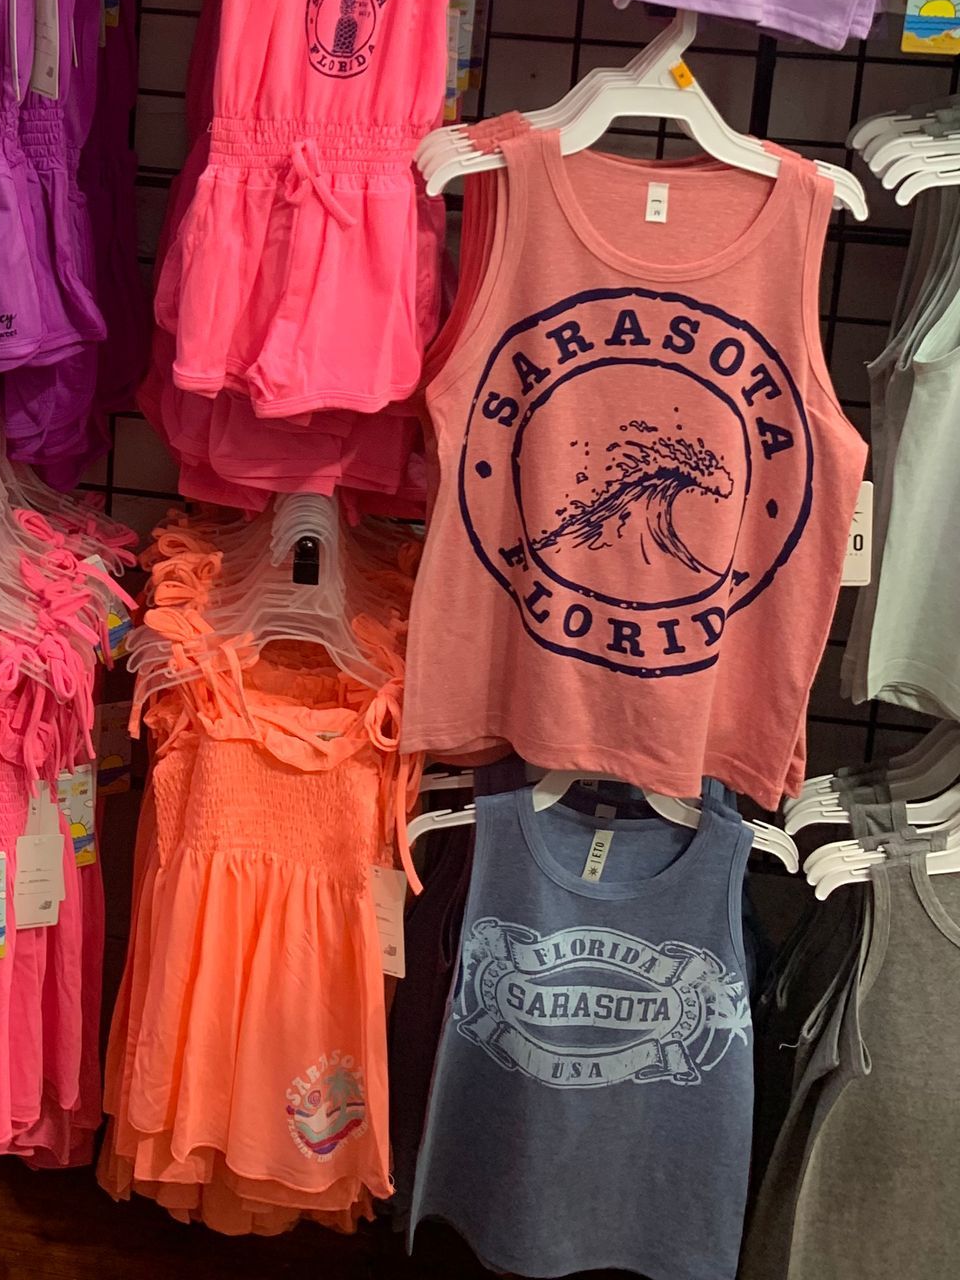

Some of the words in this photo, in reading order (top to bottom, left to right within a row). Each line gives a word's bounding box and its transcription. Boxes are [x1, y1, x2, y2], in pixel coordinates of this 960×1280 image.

[310, 43, 376, 73] FLORIDA
[482, 309, 795, 460] SARASOTA
[498, 538, 750, 658] FLORIDA
[592, 841, 605, 859] ETO
[533, 938, 660, 974] FLORIDA
[506, 982, 671, 1023] SARASOTA
[551, 1061, 604, 1079] USA
